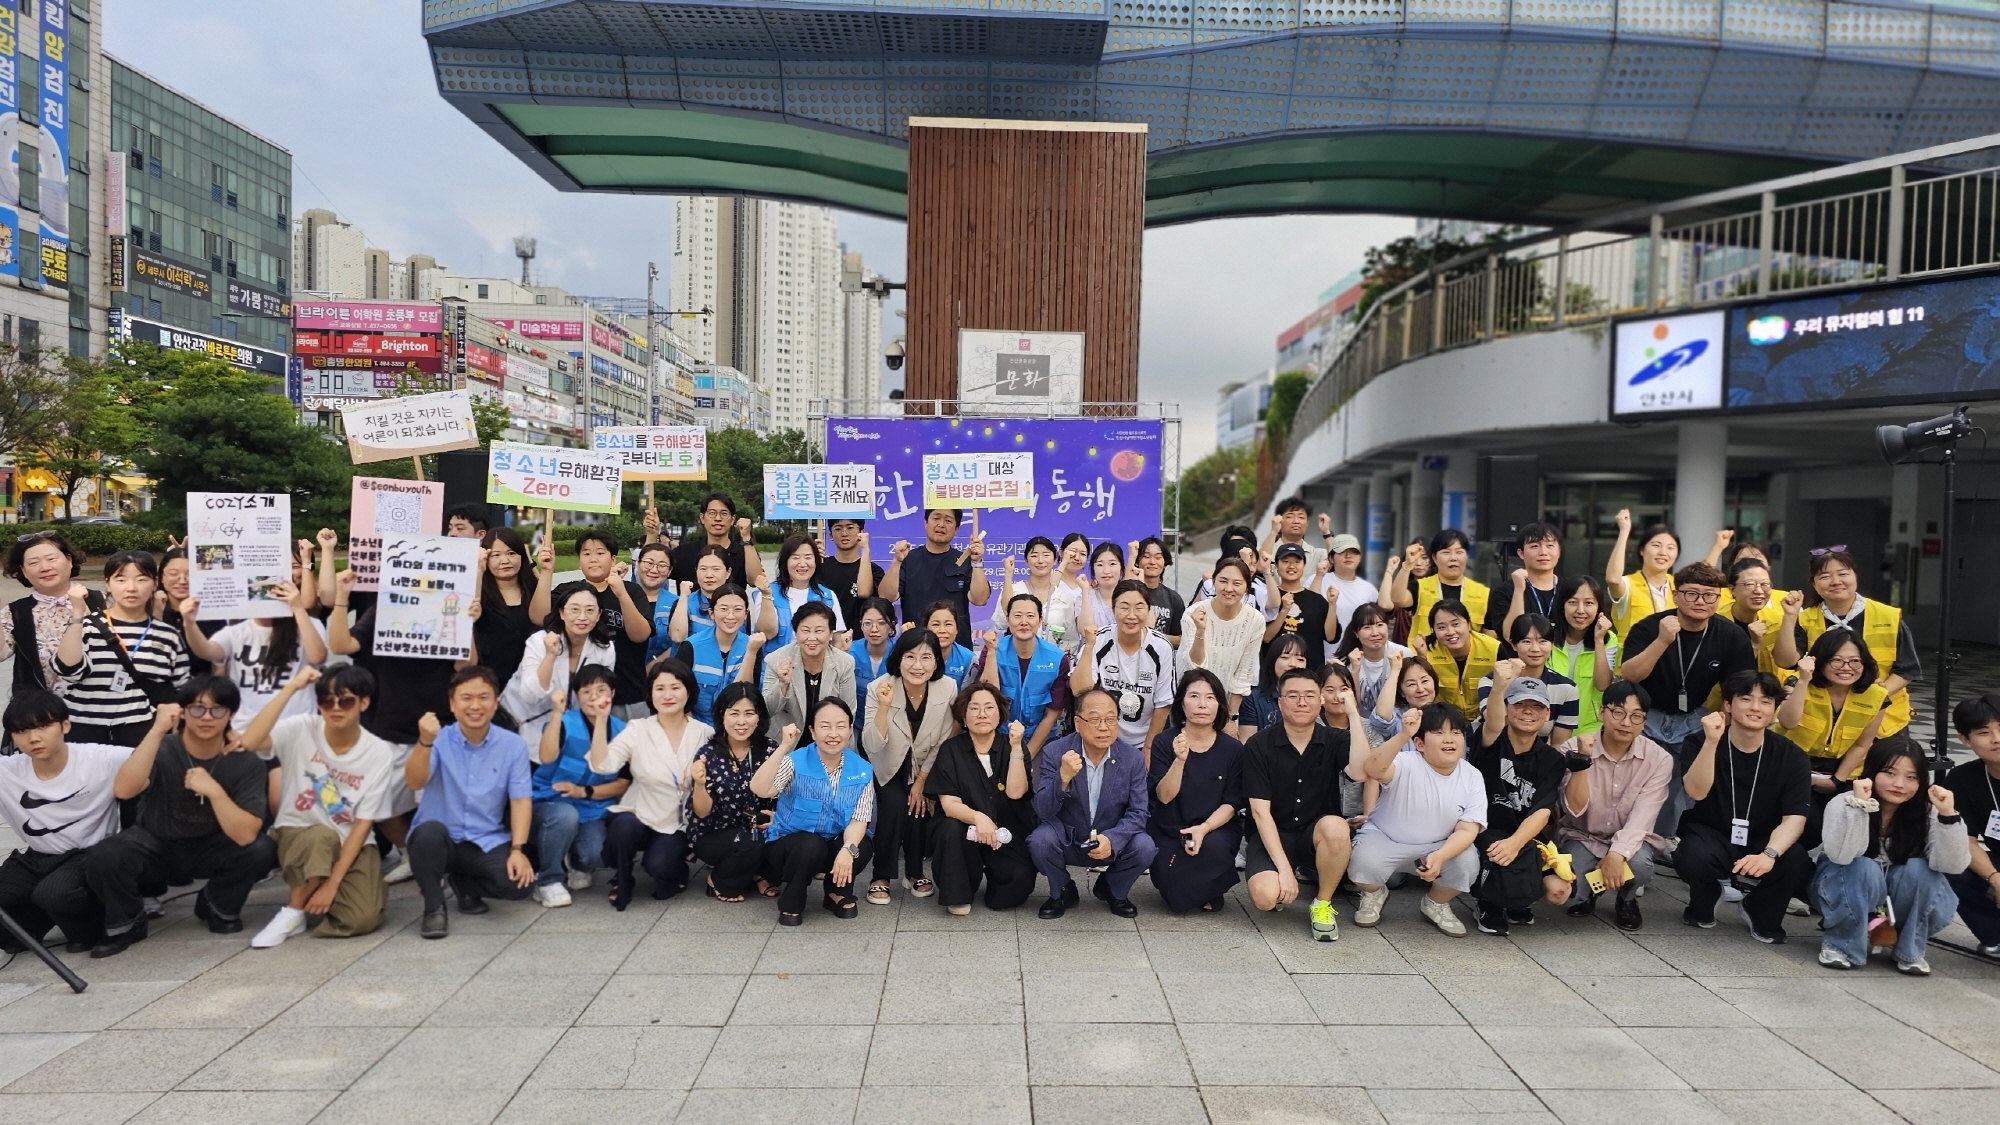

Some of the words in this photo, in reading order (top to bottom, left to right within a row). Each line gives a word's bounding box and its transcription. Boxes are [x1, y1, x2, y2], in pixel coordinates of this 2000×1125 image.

[41, 246, 67, 271] 무료
[41, 266, 67, 282] 국가검진
[147, 265, 165, 279] 세무사
[193, 280, 210, 293] 사무소
[240, 289, 262, 310] 가람
[281, 303, 291, 317] 4F
[299, 306, 351, 320] 브라이튼
[353, 308, 383, 321] 어학원
[386, 309, 415, 322] 초등부
[418, 311, 438, 323] 모집
[521, 322, 561, 334] 미술학원
[1793, 316, 1823, 335] 우리
[1825, 310, 1884, 332] 뮤지컬의
[1887, 308, 1904, 325] 힘
[1906, 306, 1925, 322] 11
[381, 339, 429, 353] Brighton
[1006, 368, 1043, 391] 문화
[365, 415, 390, 427] 지킬
[392, 411, 415, 424] 것은
[418, 406, 453, 419] 지키는
[363, 429, 399, 443] 어른이
[402, 421, 464, 438] 되겠습니다.
[595, 434, 648, 449] 청소년을
[652, 434, 705, 449] 유해환경
[494, 451, 557, 476] 청소년
[558, 461, 620, 482] 유해환경
[618, 451, 657, 465] 로부터
[658, 450, 694, 467] 보호
[926, 462, 978, 480] 청소년
[988, 461, 1014, 476] 대상
[523, 477, 571, 497] Zero
[776, 471, 828, 489] 청소년
[831, 475, 857, 489] 지켜
[988, 480, 1019, 497] 근절
[776, 489, 829, 506] 보호법
[829, 490, 869, 504] 주세요
[1050, 469, 1116, 522] 동행
[985, 543, 1027, 555] 유관기관
[377, 629, 403, 638] with
[405, 632, 431, 642] cozy
